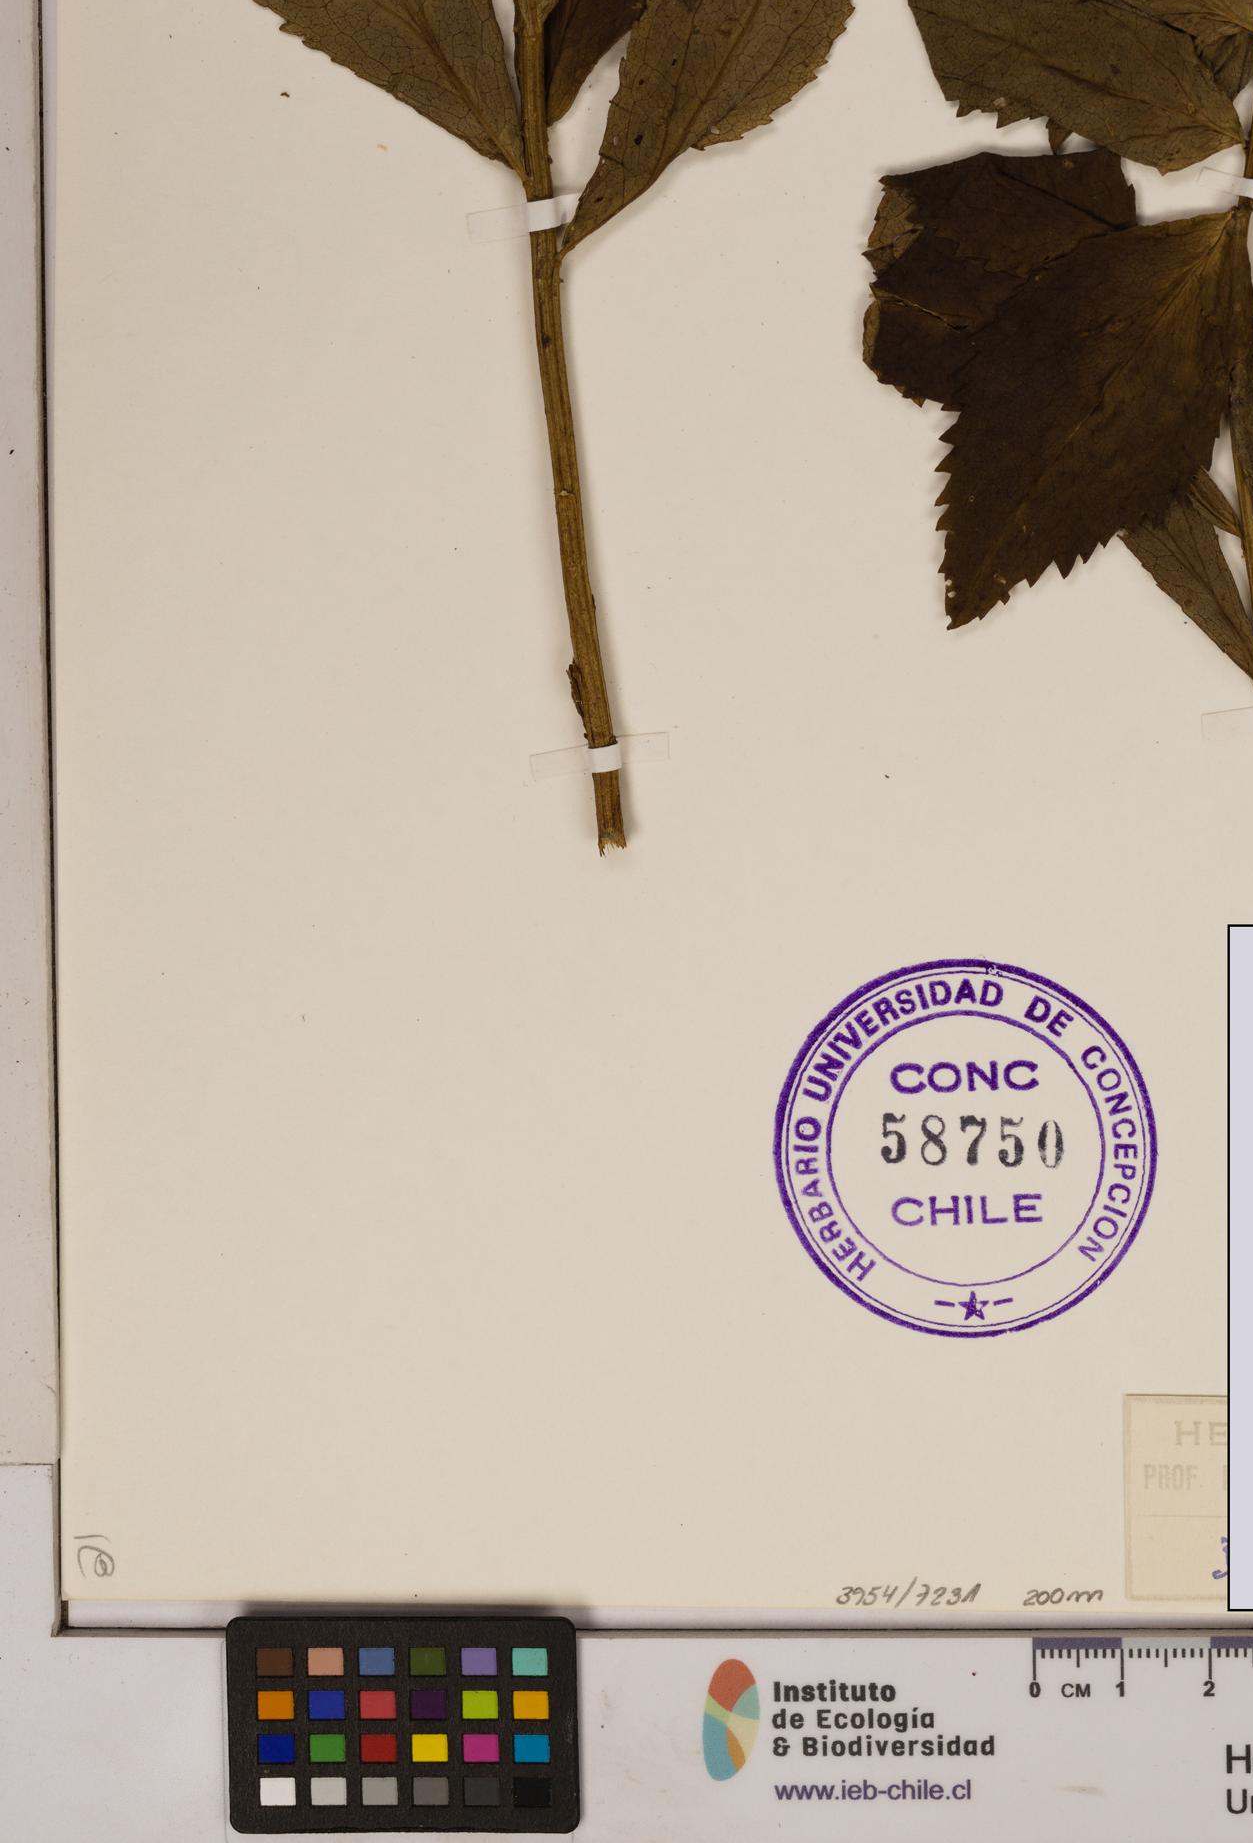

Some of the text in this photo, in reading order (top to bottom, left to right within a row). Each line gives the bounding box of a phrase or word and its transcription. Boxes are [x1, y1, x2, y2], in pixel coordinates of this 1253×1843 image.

[890, 1059, 1040, 1095] CONC
[793, 978, 1139, 1282] HERBARIO UNIVERSIDAD DE CONCEPCION
[880, 1112, 1064, 1169] 58750
[891, 1193, 1043, 1227] CHILE
[773, 1678, 897, 1703] Instituto
[1028, 1681, 1042, 1699] 0
[1060, 1682, 1091, 1699] CM
[1115, 1680, 1125, 1698] 1
[1202, 1680, 1216, 1698] 2
[771, 1706, 935, 1734] de Ecología
[772, 1734, 995, 1757] & Biodiversidad
[773, 1778, 972, 1801] www.ieb-chile.cl
